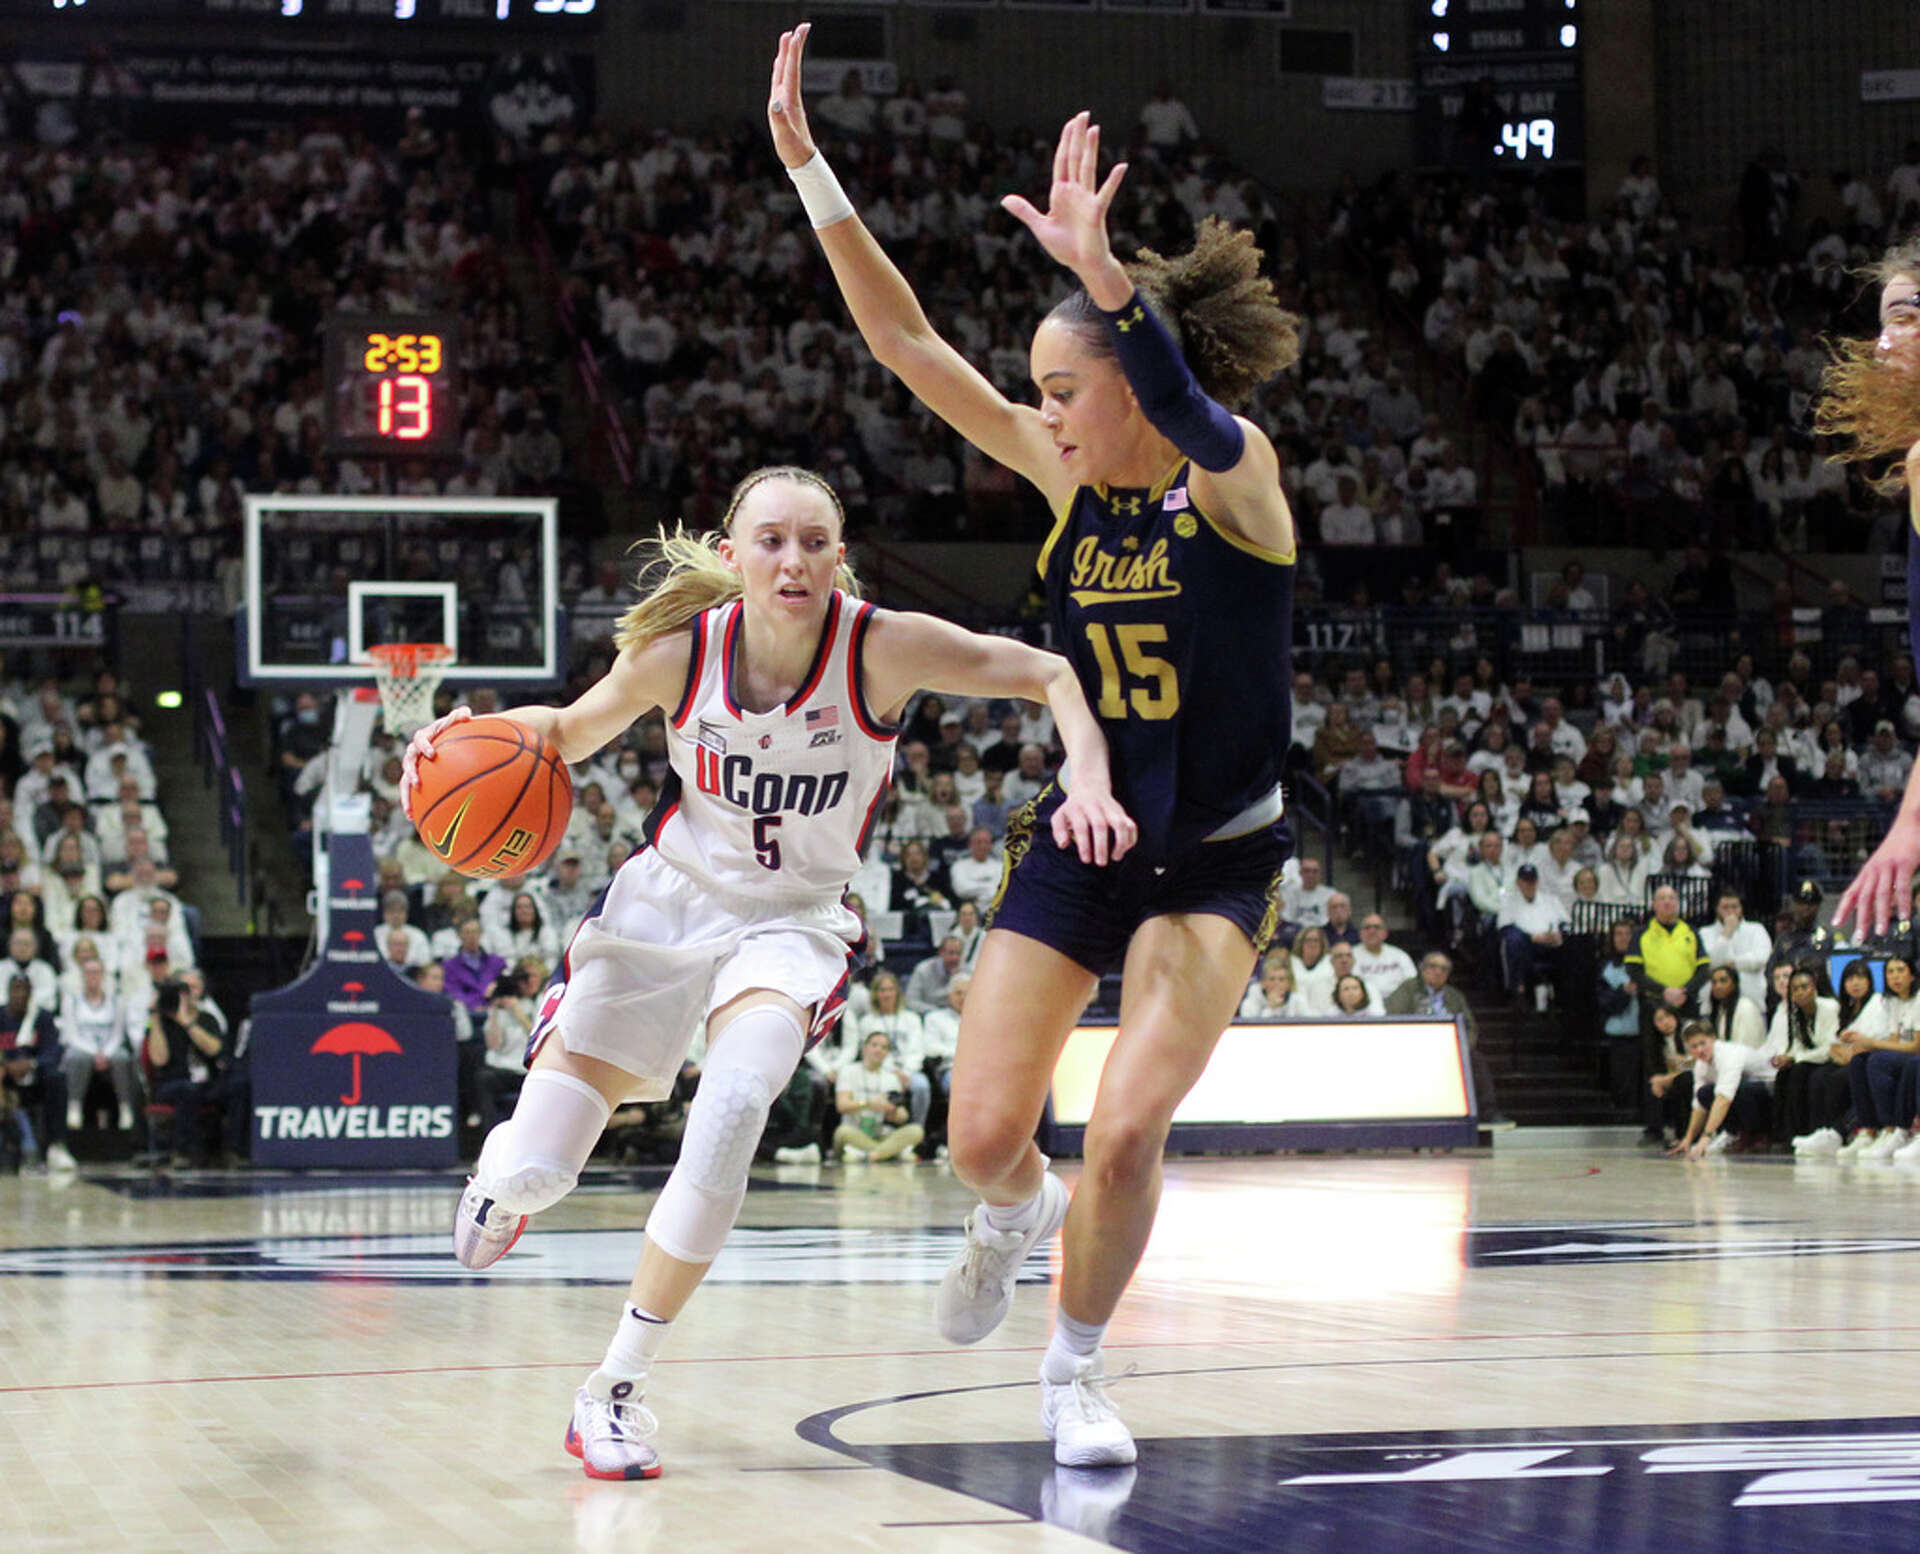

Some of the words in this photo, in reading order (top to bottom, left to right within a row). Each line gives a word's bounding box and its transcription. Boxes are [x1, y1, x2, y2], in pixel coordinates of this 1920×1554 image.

[364, 333, 442, 374] 2:53
[378, 374, 433, 440] 13
[1070, 535, 1182, 597] Irish
[53, 611, 104, 638] 114
[1305, 622, 1354, 650] 117
[1085, 622, 1180, 721] 15
[753, 816, 783, 871] 5
[254, 1105, 453, 1140] TRAVELERS
